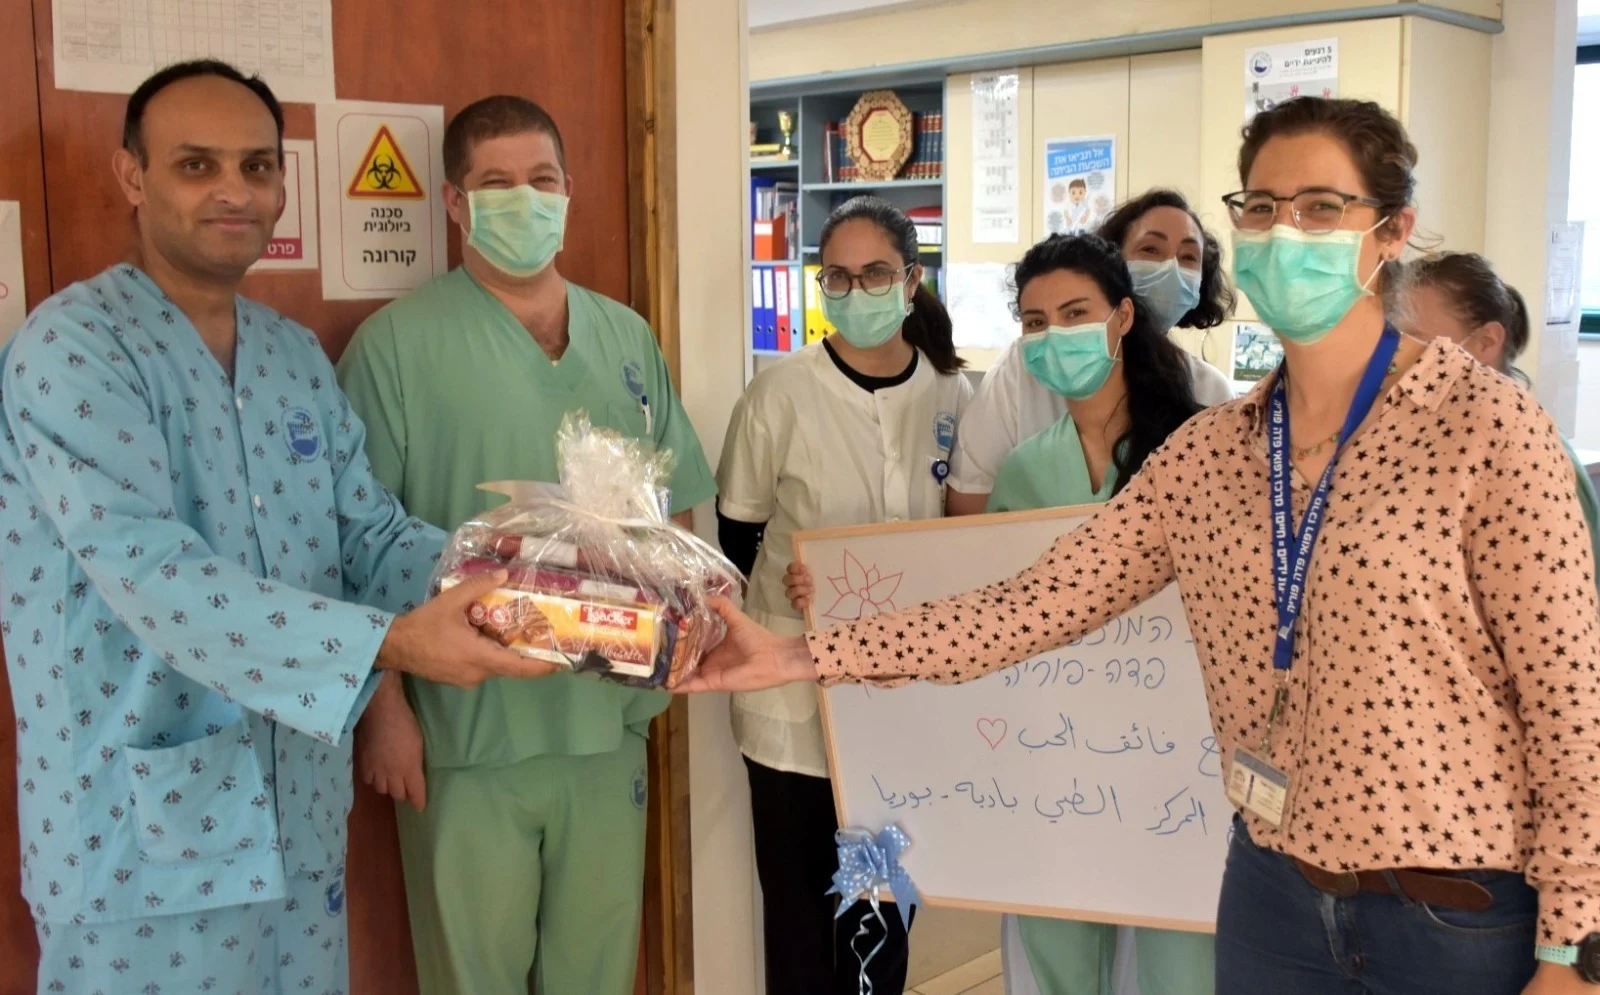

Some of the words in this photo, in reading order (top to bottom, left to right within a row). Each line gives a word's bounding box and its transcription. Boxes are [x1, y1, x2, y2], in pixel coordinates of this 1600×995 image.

[363, 219, 411, 232] ביולוגית
[370, 207, 403, 219] סכנה
[362, 249, 417, 267] קורונה
[1272, 427, 1283, 448] פדה
[1273, 450, 1283, 478] רפואי
[1274, 480, 1285, 507] מרכז
[1306, 497, 1322, 524] מרכז
[1299, 526, 1315, 556] רפואי
[1292, 557, 1306, 582] פדה
[1286, 584, 1300, 614] פוריה
[1018, 712, 1075, 754] الحب
[1035, 777, 1122, 824] الطبي
[1145, 786, 1208, 836] المركز
